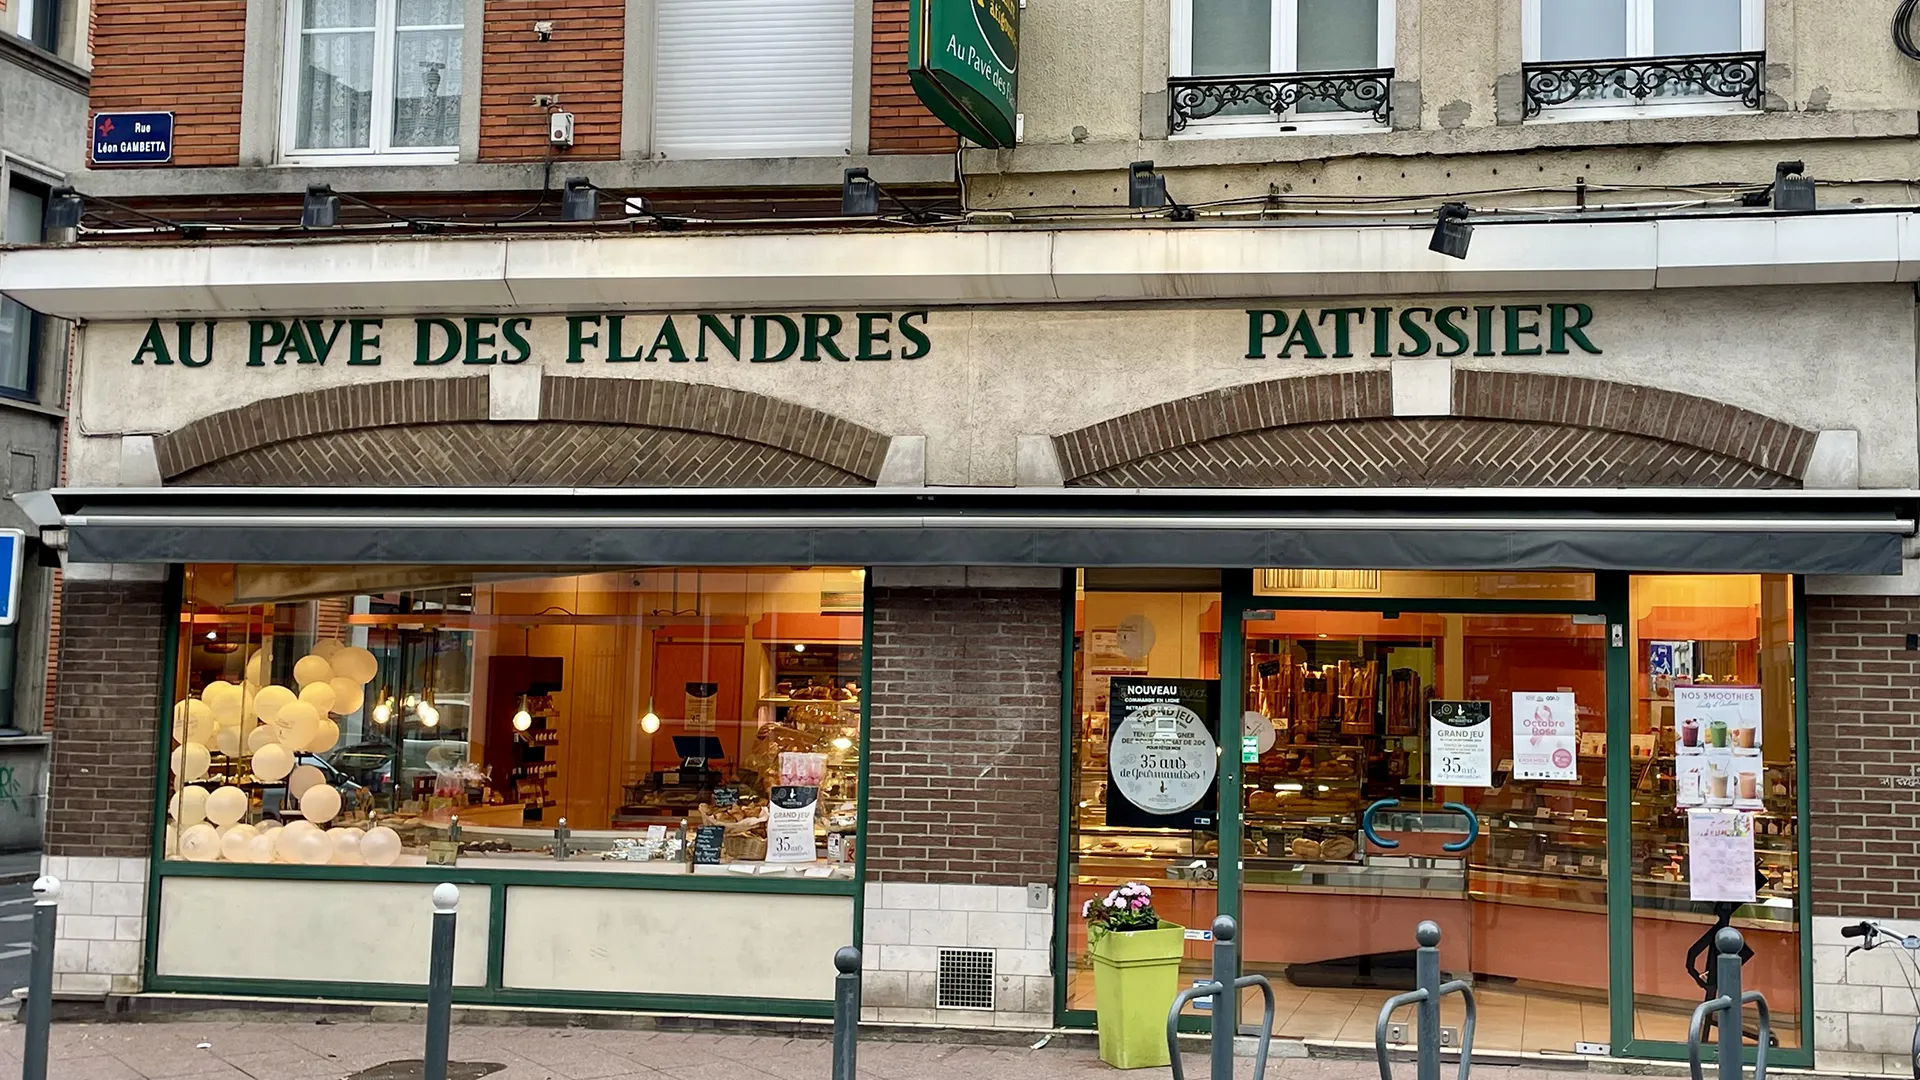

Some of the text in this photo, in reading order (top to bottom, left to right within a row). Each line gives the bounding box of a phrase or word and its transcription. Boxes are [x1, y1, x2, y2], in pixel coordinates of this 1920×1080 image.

[946, 34, 1006, 96] Au Pavé des
[134, 122, 151, 133] Rue
[97, 141, 166, 153] Léon GAMBETTA
[1245, 303, 1603, 358] PATISSIER
[131, 311, 932, 367] AU PAVE DES FLANDRES
[1127, 685, 1177, 695] NOUVEAU
[1704, 692, 1755, 700] SMOOTHIES
[1175, 709, 1194, 724] JEU
[1523, 719, 1565, 727] Octobre
[1438, 730, 1484, 739] GRAND JEU
[1532, 727, 1557, 735] Rose
[1141, 754, 1186, 769] 35 ans
[1442, 757, 1461, 773] 35
[1120, 768, 1131, 778] de
[773, 811, 810, 820] GRAND JEU
[776, 836, 790, 852] 35
